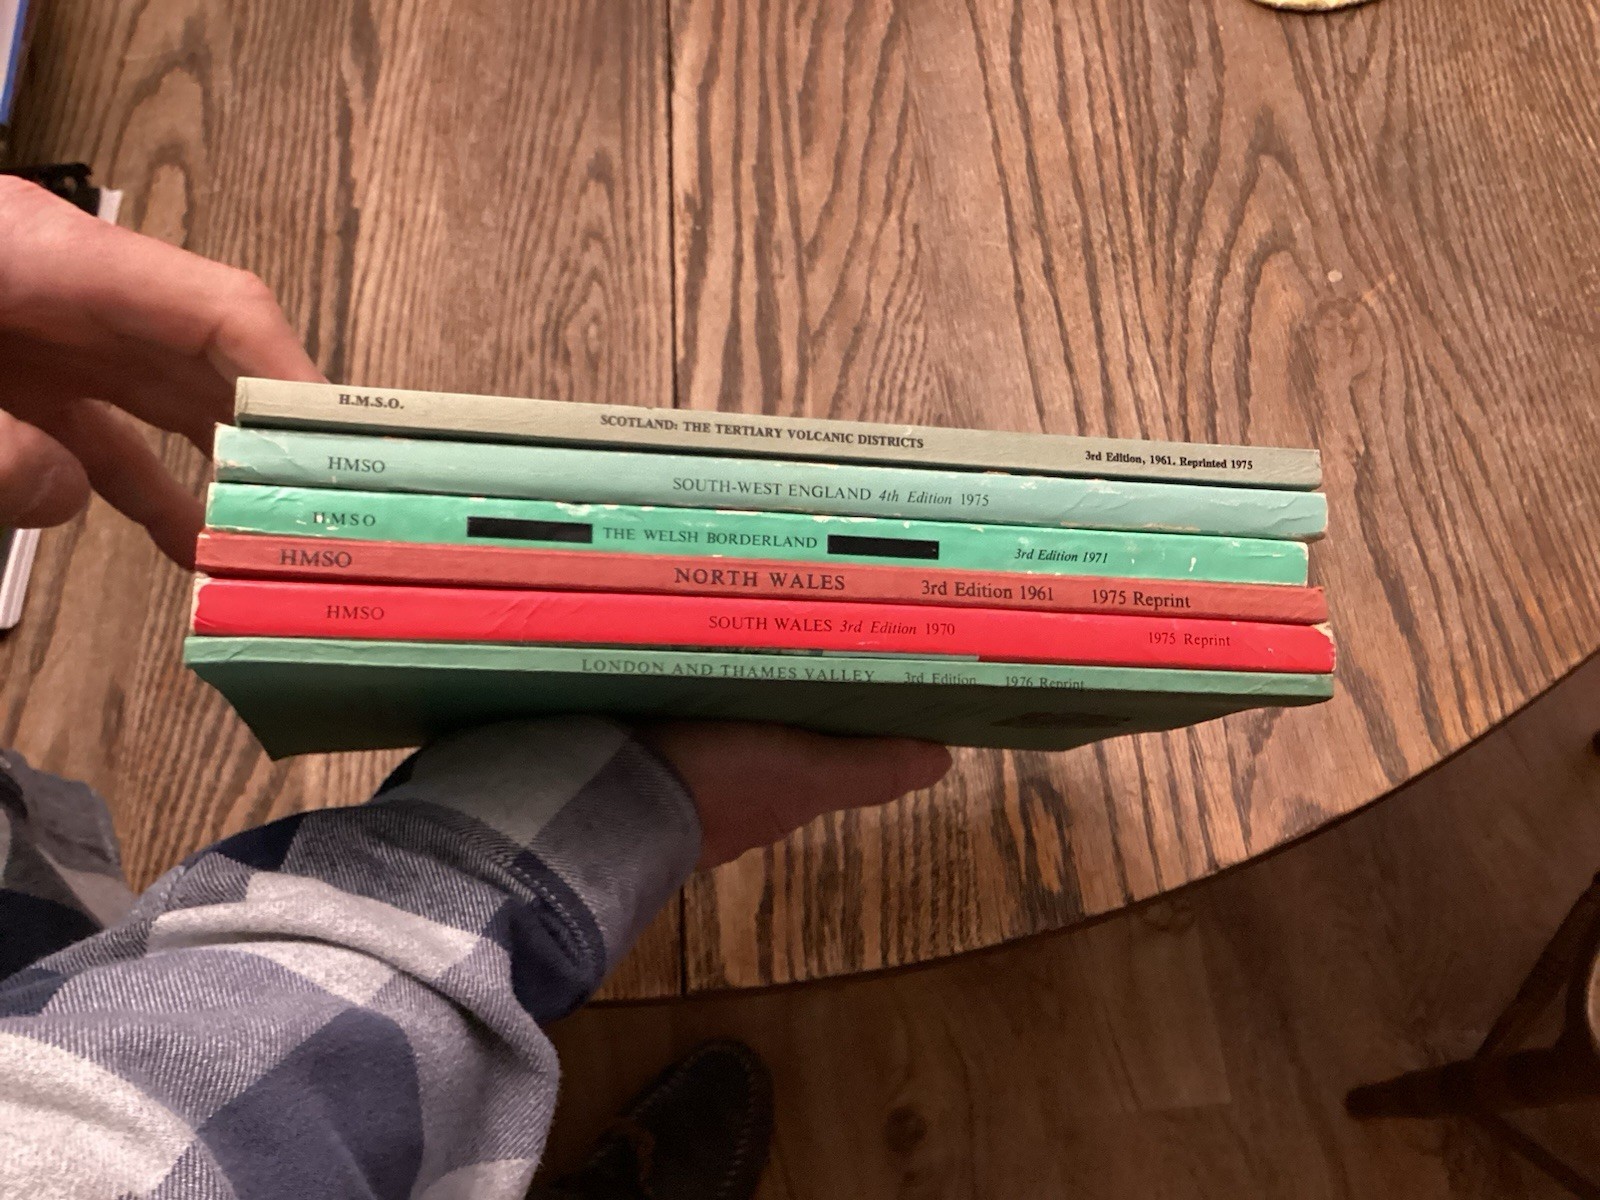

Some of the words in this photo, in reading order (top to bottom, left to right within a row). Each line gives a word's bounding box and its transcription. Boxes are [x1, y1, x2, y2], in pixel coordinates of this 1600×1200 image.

[339, 394, 404, 409] H.M.S.O.
[600, 414, 678, 430] SCOTLAND:
[683, 421, 711, 433] THE
[715, 423, 783, 439] TERTIARY
[788, 429, 854, 444] VOLCANIC
[858, 434, 924, 449] DISTRICTS
[328, 456, 386, 473] HMSO
[1085, 451, 1102, 461] 3rd
[1106, 452, 1146, 465] Edition,
[1150, 455, 1176, 466] 1961.
[1180, 457, 1227, 469] Reprinted
[1231, 460, 1253, 470] 1975
[673, 478, 782, 495] SOUTH-WEST
[788, 483, 872, 501] ENGLAND
[879, 489, 899, 502] 4th
[907, 490, 952, 505] Edition
[960, 493, 989, 507] 1975
[312, 511, 376, 527] HMSO
[603, 527, 635, 540] THE
[644, 529, 699, 543] WELSH
[707, 532, 817, 548] BORDERLAND
[280, 549, 353, 568] HMSO
[1014, 548, 1033, 560] 3rd
[1037, 549, 1078, 562] Edition
[1082, 551, 1108, 564] 1971
[674, 567, 758, 587] NORTH
[769, 572, 846, 591] WALES
[921, 580, 947, 596] 3rd
[954, 581, 1013, 599] Edition
[1020, 585, 1054, 601] 1961
[1092, 589, 1126, 605] 1975
[1133, 591, 1191, 610] Reprint
[326, 605, 384, 620] HMSO
[709, 615, 768, 630] SOUTH
[774, 618, 832, 632] WALES
[840, 620, 862, 633] 3rd
[870, 621, 917, 635] Edition
[925, 623, 955, 636] 1970
[1149, 632, 1176, 645] 1975
[1184, 633, 1231, 648] Reprint
[581, 659, 664, 674] LONDON
[670, 663, 713, 676] AND
[721, 664, 797, 680] THAMES
[804, 667, 875, 682] VALLEY
[905, 672, 924, 683] 3rd
[932, 672, 977, 685] Edition
[1005, 676, 1034, 688] 1976
[1039, 677, 1084, 690] Reprint
